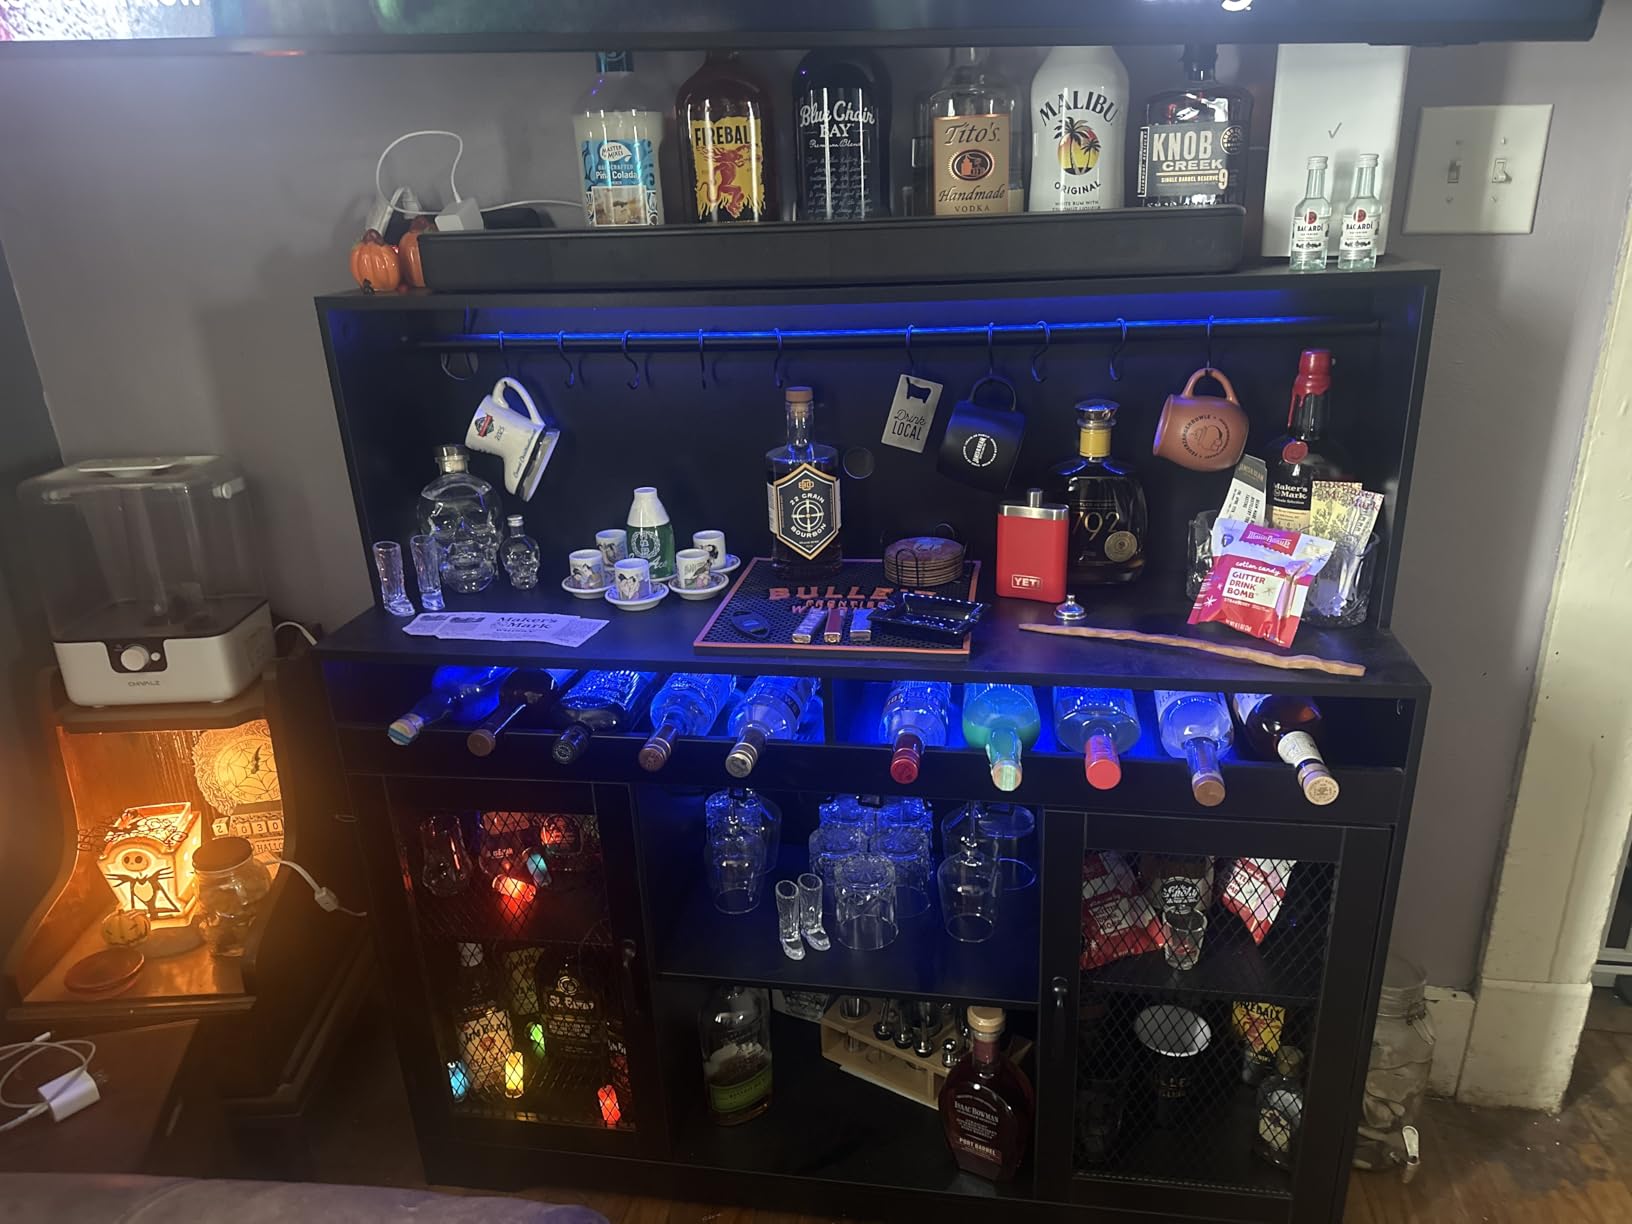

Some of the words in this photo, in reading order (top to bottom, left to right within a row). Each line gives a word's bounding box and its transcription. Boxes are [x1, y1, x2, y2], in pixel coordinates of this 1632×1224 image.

[800, 104, 832, 127] Blue
[833, 100, 876, 125] Chair
[1039, 90, 1118, 126] MALIBU
[1152, 130, 1213, 161] KNOB
[1162, 159, 1223, 171] CREEK
[1218, 168, 1229, 190] 9
[938, 183, 1005, 203] Handmade
[1055, 181, 1101, 195] ORIGINAL
[954, 205, 990, 213] VODKA
[894, 409, 926, 425] Drink
[892, 421, 922, 440] LOCAL
[1281, 491, 1308, 499] Mark
[790, 523, 827, 539] BOURBON
[1235, 560, 1257, 570] cotton
[1257, 564, 1282, 576] candy
[1013, 576, 1041, 587] YETI
[1229, 579, 1256, 591] DRINK
[1232, 571, 1266, 585] GLITTER
[1226, 588, 1255, 599] BOMB
